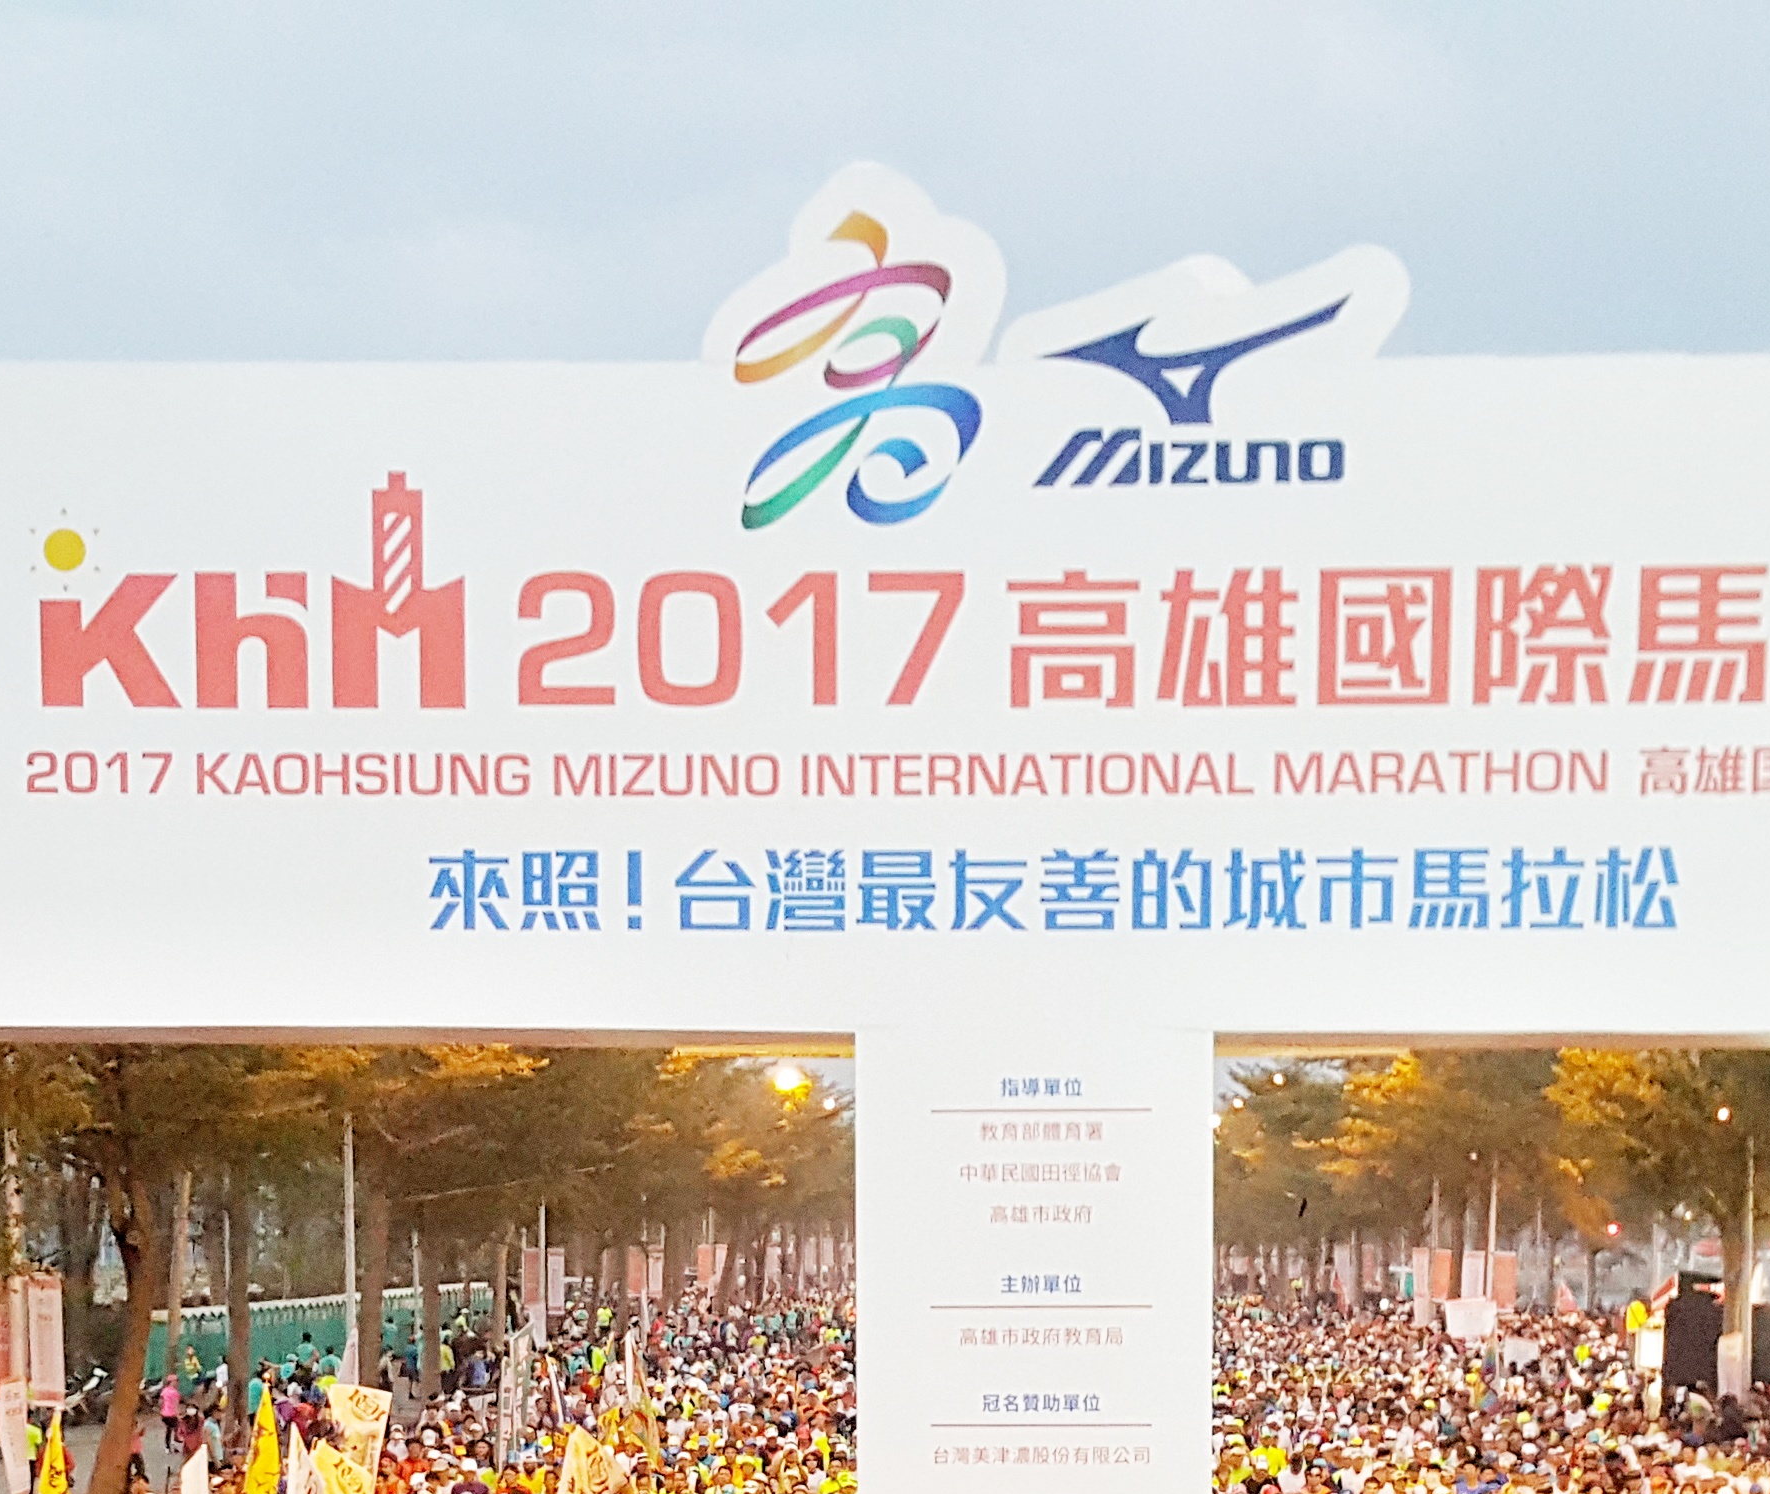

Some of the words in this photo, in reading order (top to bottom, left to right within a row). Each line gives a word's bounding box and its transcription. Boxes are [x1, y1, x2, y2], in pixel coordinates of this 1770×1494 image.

[1034, 426, 1346, 487] MIZUNO
[517, 570, 966, 708] 2017
[26, 751, 175, 797] 2017
[195, 752, 531, 797] KAOHSIUNG
[553, 752, 780, 797] MIZUNO
[802, 751, 1255, 797] INTERNATIONAL
[1274, 750, 1609, 796] MARATHON
[1000, 1076, 1083, 1099] 指導單位
[980, 1121, 1104, 1142] 教育部體育署
[959, 1162, 1122, 1184] 中華民國田徑協會
[989, 1204, 1093, 1225] 高雄市政府
[1000, 1273, 1083, 1294] 主辦單位
[959, 1326, 1124, 1348] 高雄市政府教育局
